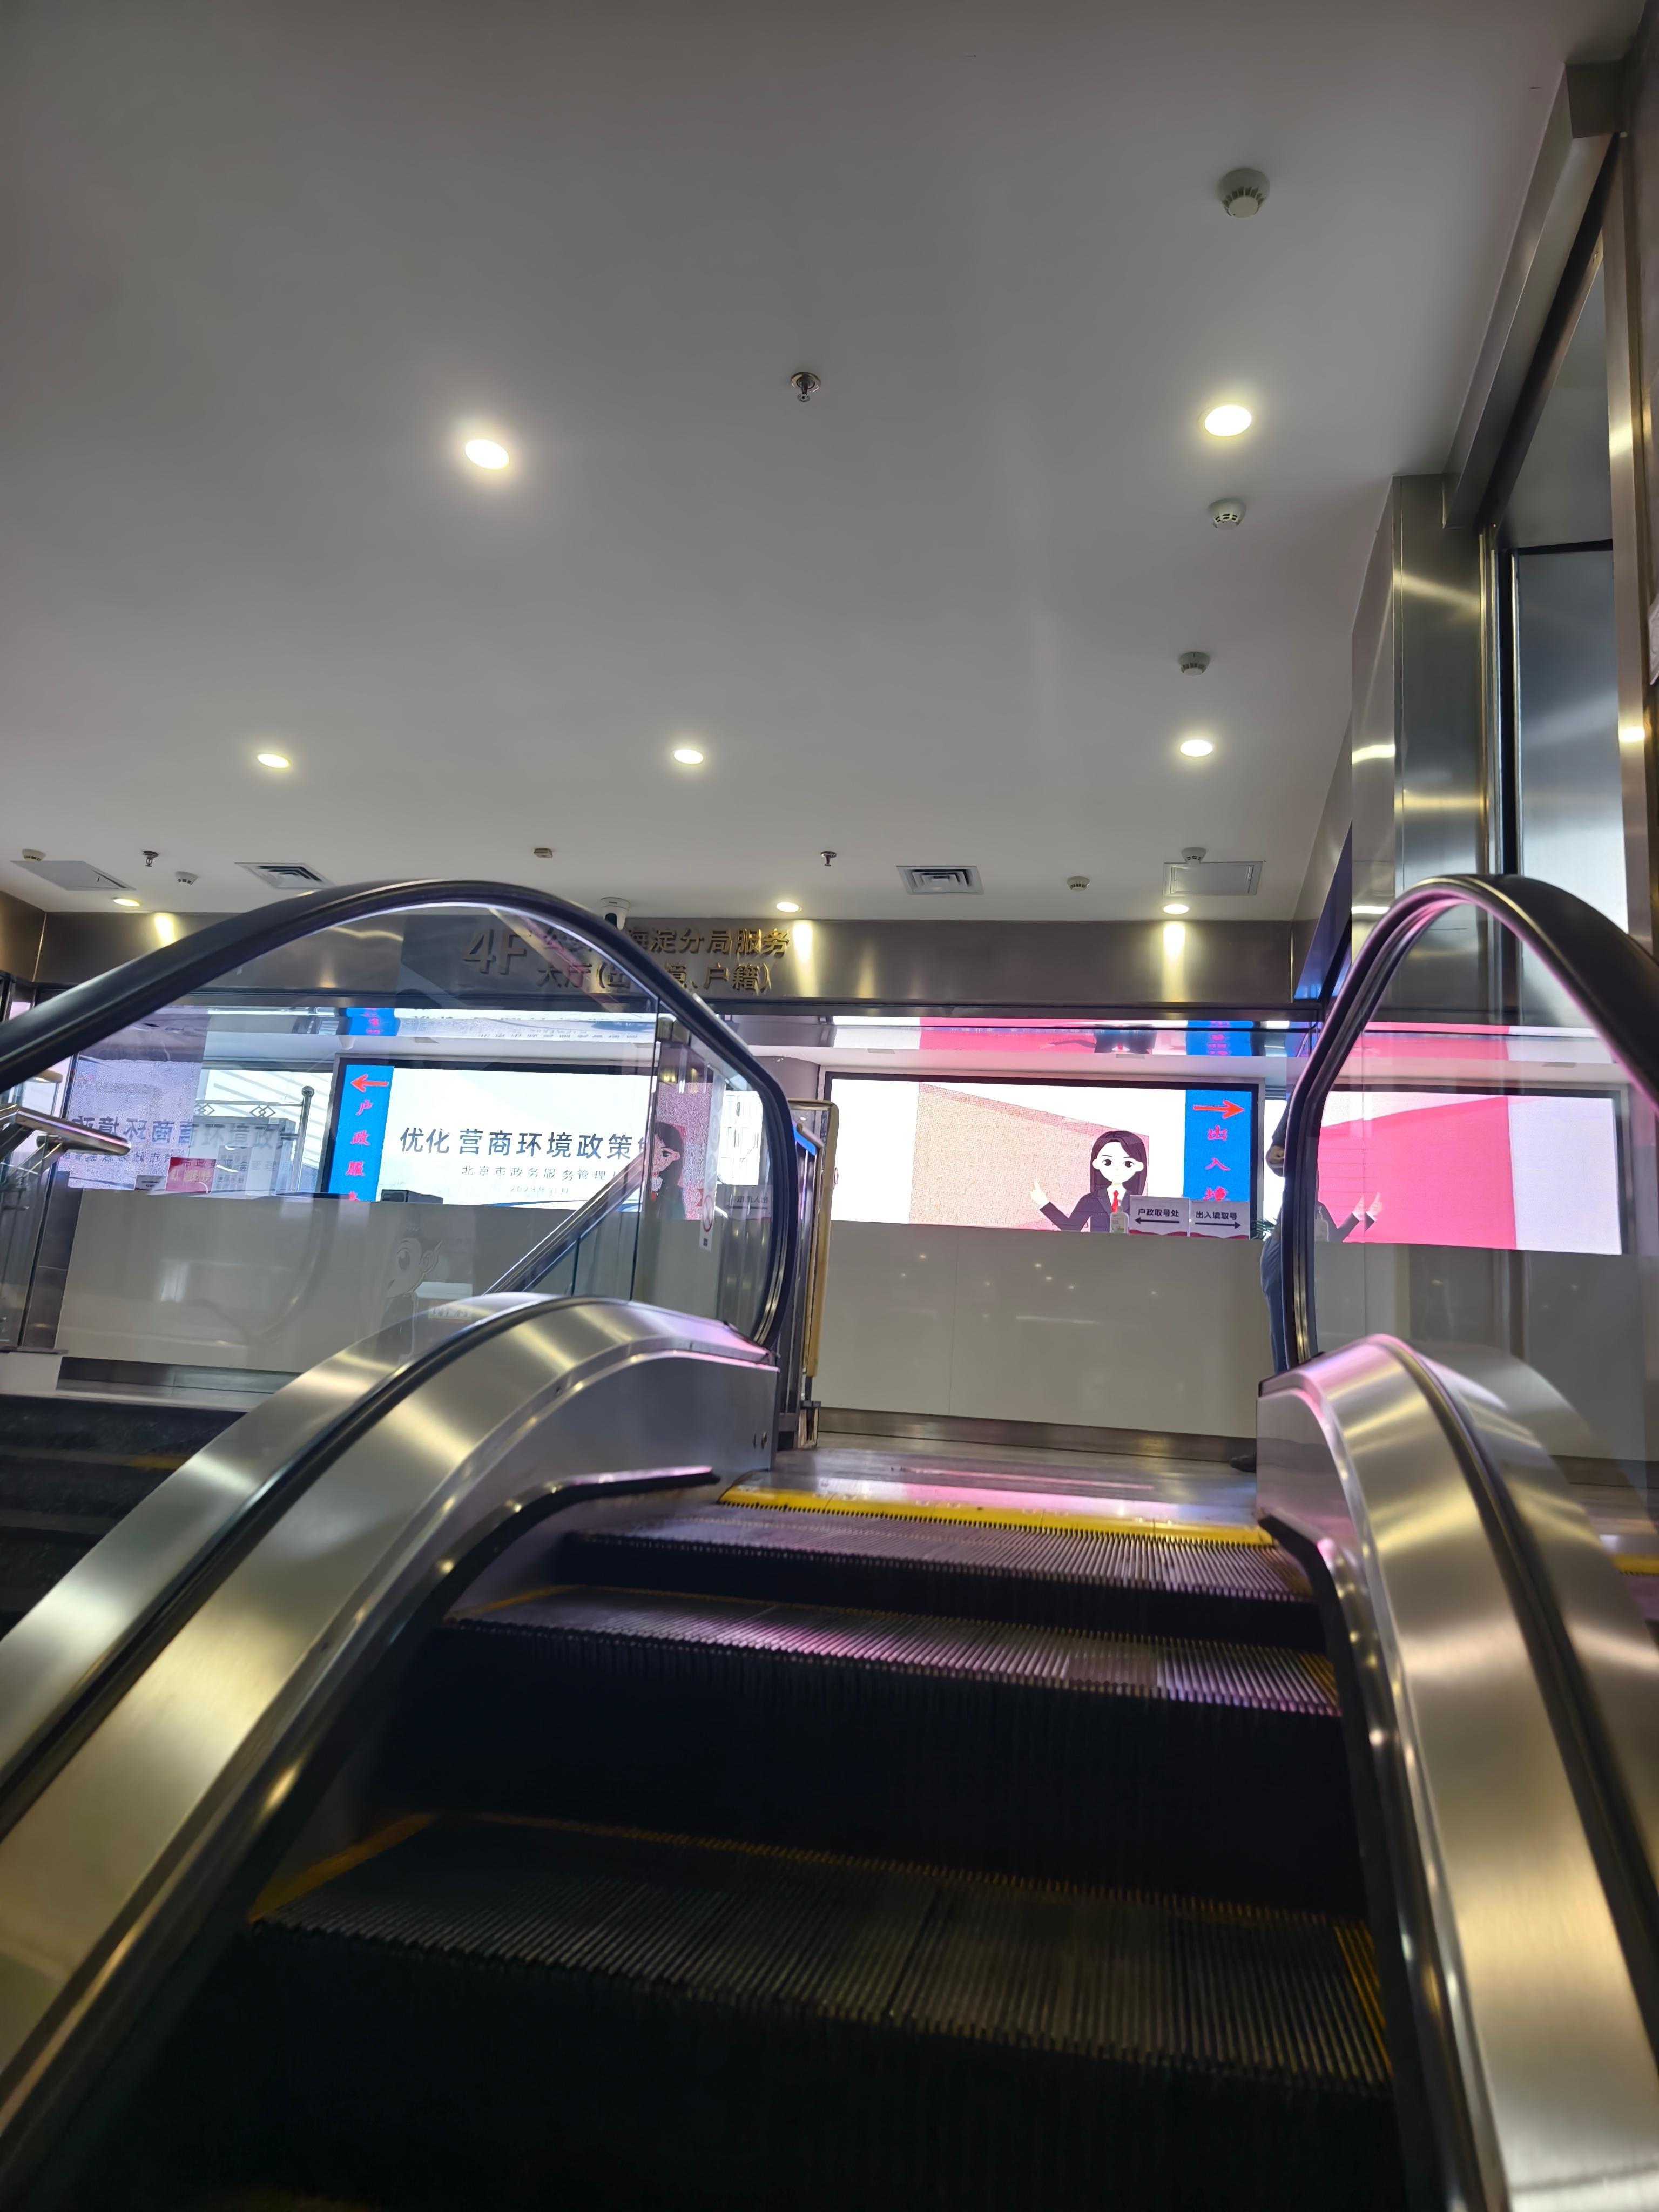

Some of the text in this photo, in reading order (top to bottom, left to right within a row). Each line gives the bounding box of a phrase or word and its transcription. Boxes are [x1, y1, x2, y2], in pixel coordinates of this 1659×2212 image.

[463, 928, 528, 975] 4F
[538, 963, 771, 992] 大厅(出境、户籍)
[462, 1165, 616, 1181] 北京市政务服务管理
[1137, 1208, 1179, 1218] 户政取号处
